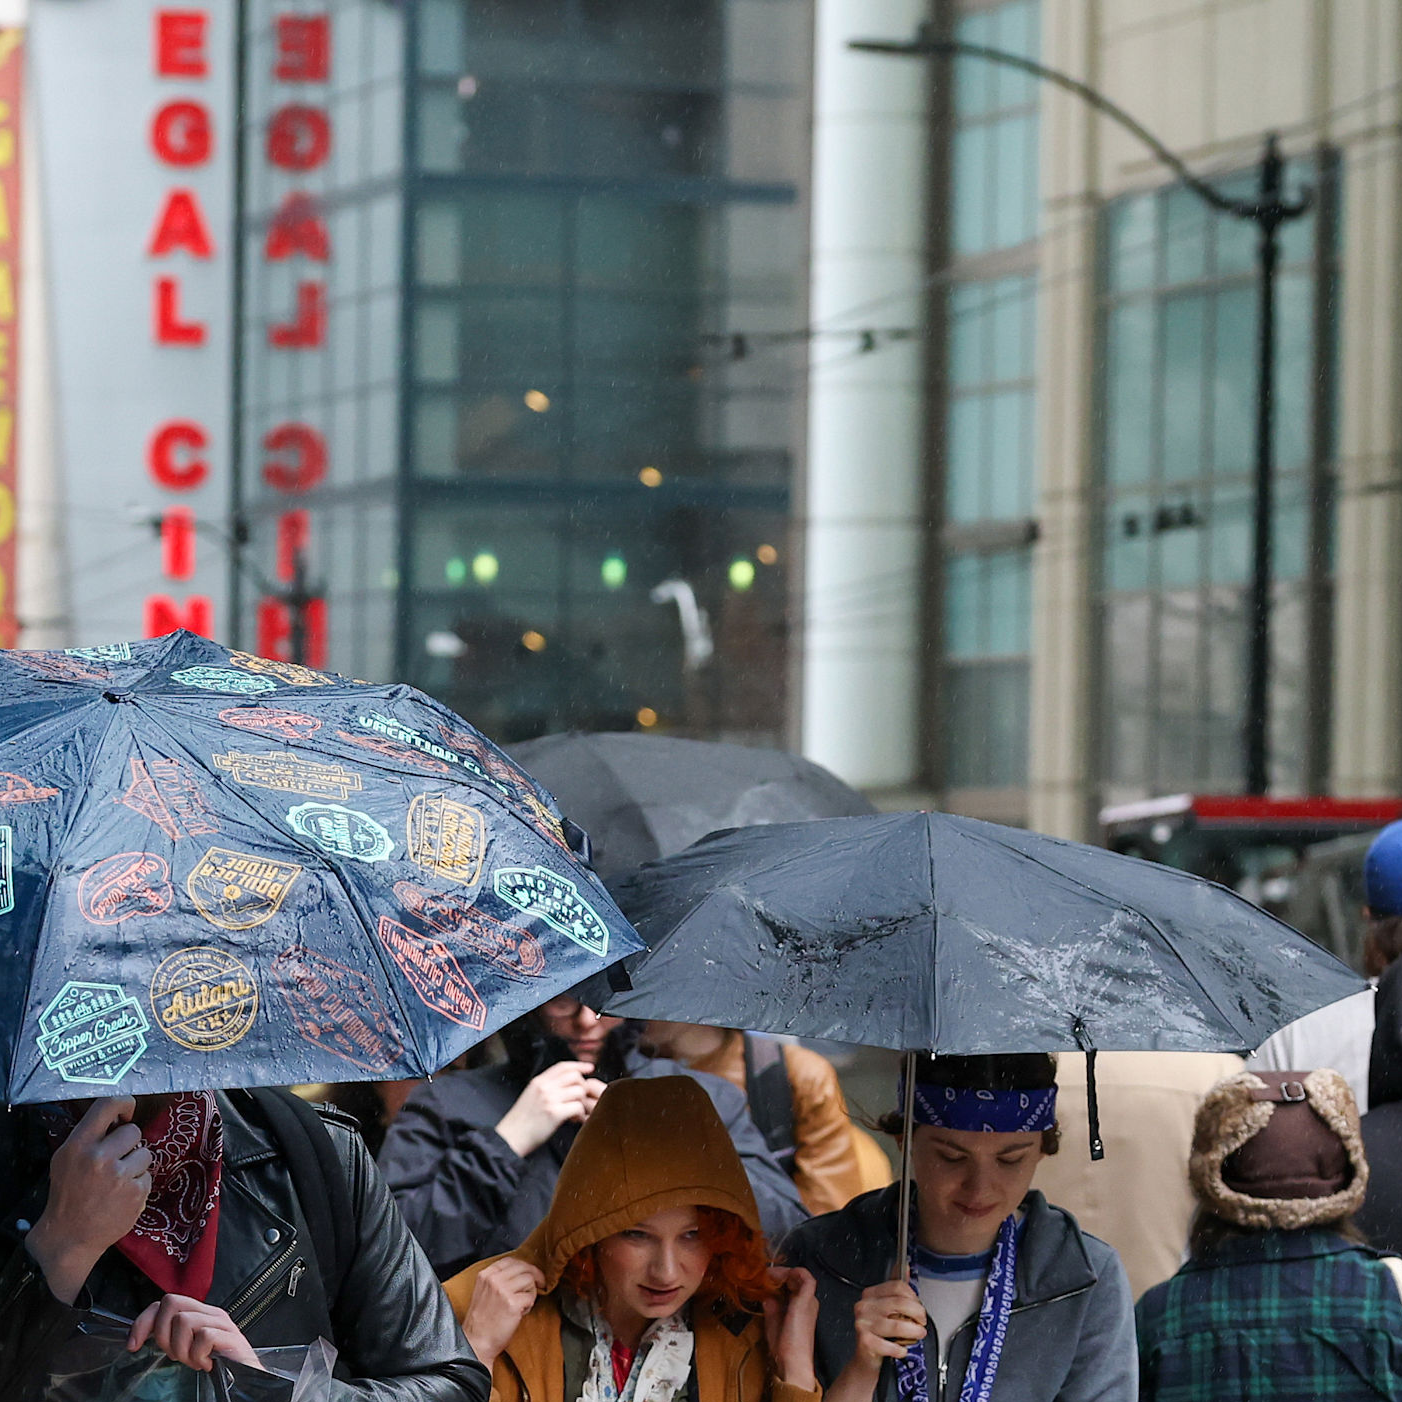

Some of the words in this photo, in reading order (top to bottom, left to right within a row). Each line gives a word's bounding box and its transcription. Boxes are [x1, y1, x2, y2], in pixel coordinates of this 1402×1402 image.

[136, 859, 160, 878] Old
[199, 863, 286, 898] BOULDER
[225, 857, 279, 879] RIDGE
[92, 886, 128, 918] West
[501, 875, 547, 891] VERO
[553, 886, 603, 938] BEACH
[531, 889, 573, 919] RESORT
[392, 931, 444, 989] CALIFORNIAN
[397, 952, 441, 1001] VILLAS
[162, 972, 252, 1023] Aulani
[437, 999, 462, 1015] THE
[443, 980, 474, 1016] GRAND
[49, 1030, 95, 1058] Copper
[94, 1010, 138, 1041] Creek
[321, 994, 384, 1056] CALIFORNIAN
[98, 1049, 105, 1060] &
[107, 1038, 135, 1054] CABINS
